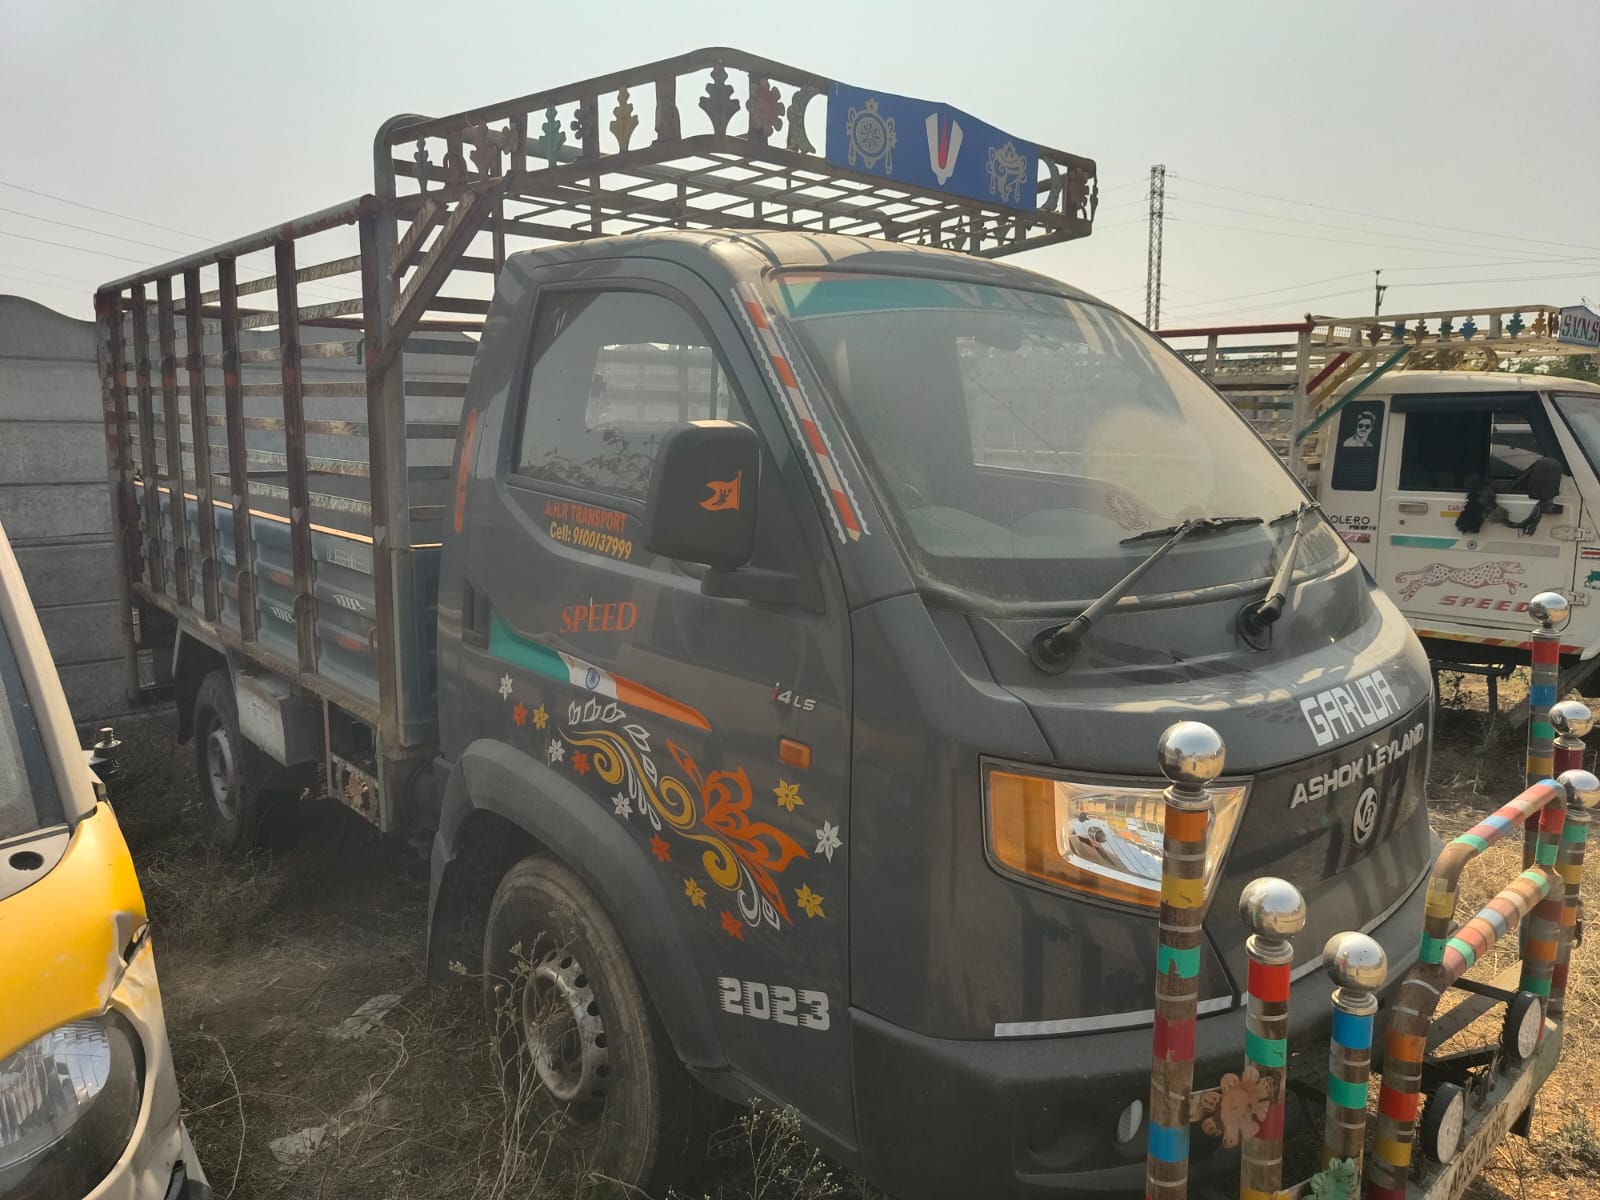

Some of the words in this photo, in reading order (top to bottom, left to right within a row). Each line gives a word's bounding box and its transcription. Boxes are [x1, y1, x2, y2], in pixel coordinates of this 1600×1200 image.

[571, 504, 627, 533] TRANSPORT
[1328, 515, 1370, 525] OLERO
[550, 521, 571, 542] Cell:
[573, 527, 632, 560] 9100137999
[560, 602, 637, 633] SPEED
[1438, 595, 1531, 613] SPEED
[1300, 670, 1401, 747] GARUDA
[1290, 758, 1364, 809] ASHOK
[1366, 722, 1425, 776] LEYLAND
[718, 977, 830, 1031] 2023
